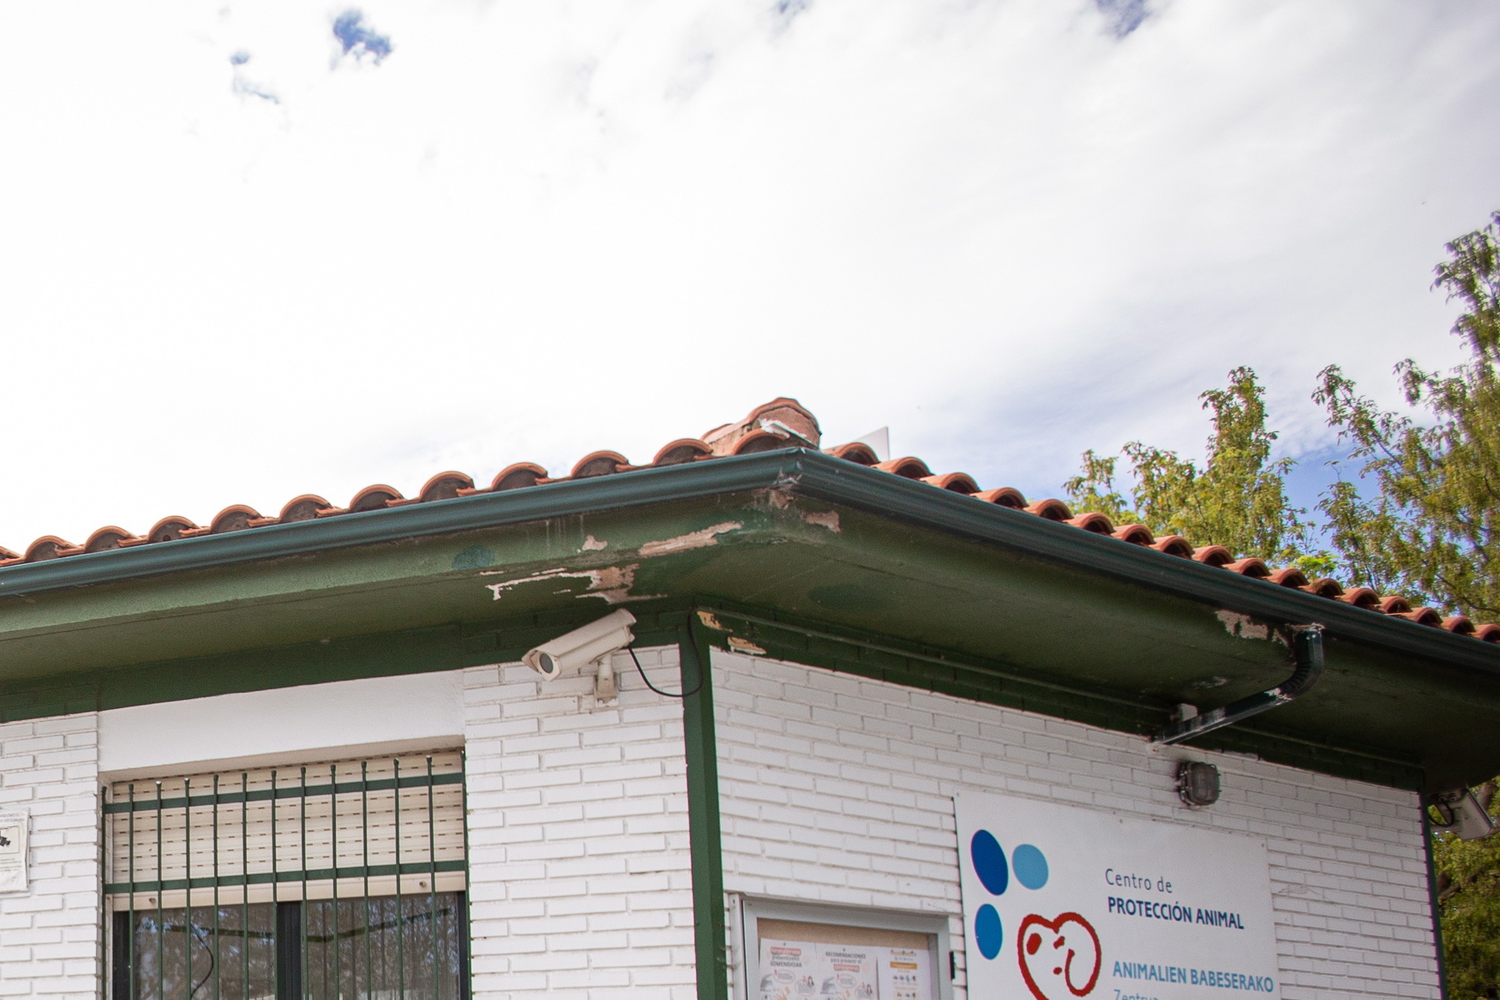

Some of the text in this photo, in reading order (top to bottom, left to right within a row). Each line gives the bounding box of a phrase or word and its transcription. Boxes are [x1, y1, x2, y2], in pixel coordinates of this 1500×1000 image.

[1105, 868, 1173, 894] Centro de
[1108, 896, 1245, 930] PROTECCIÓN ANIMAL
[1113, 960, 1274, 993] ANIMALIEN BABESERAKO
